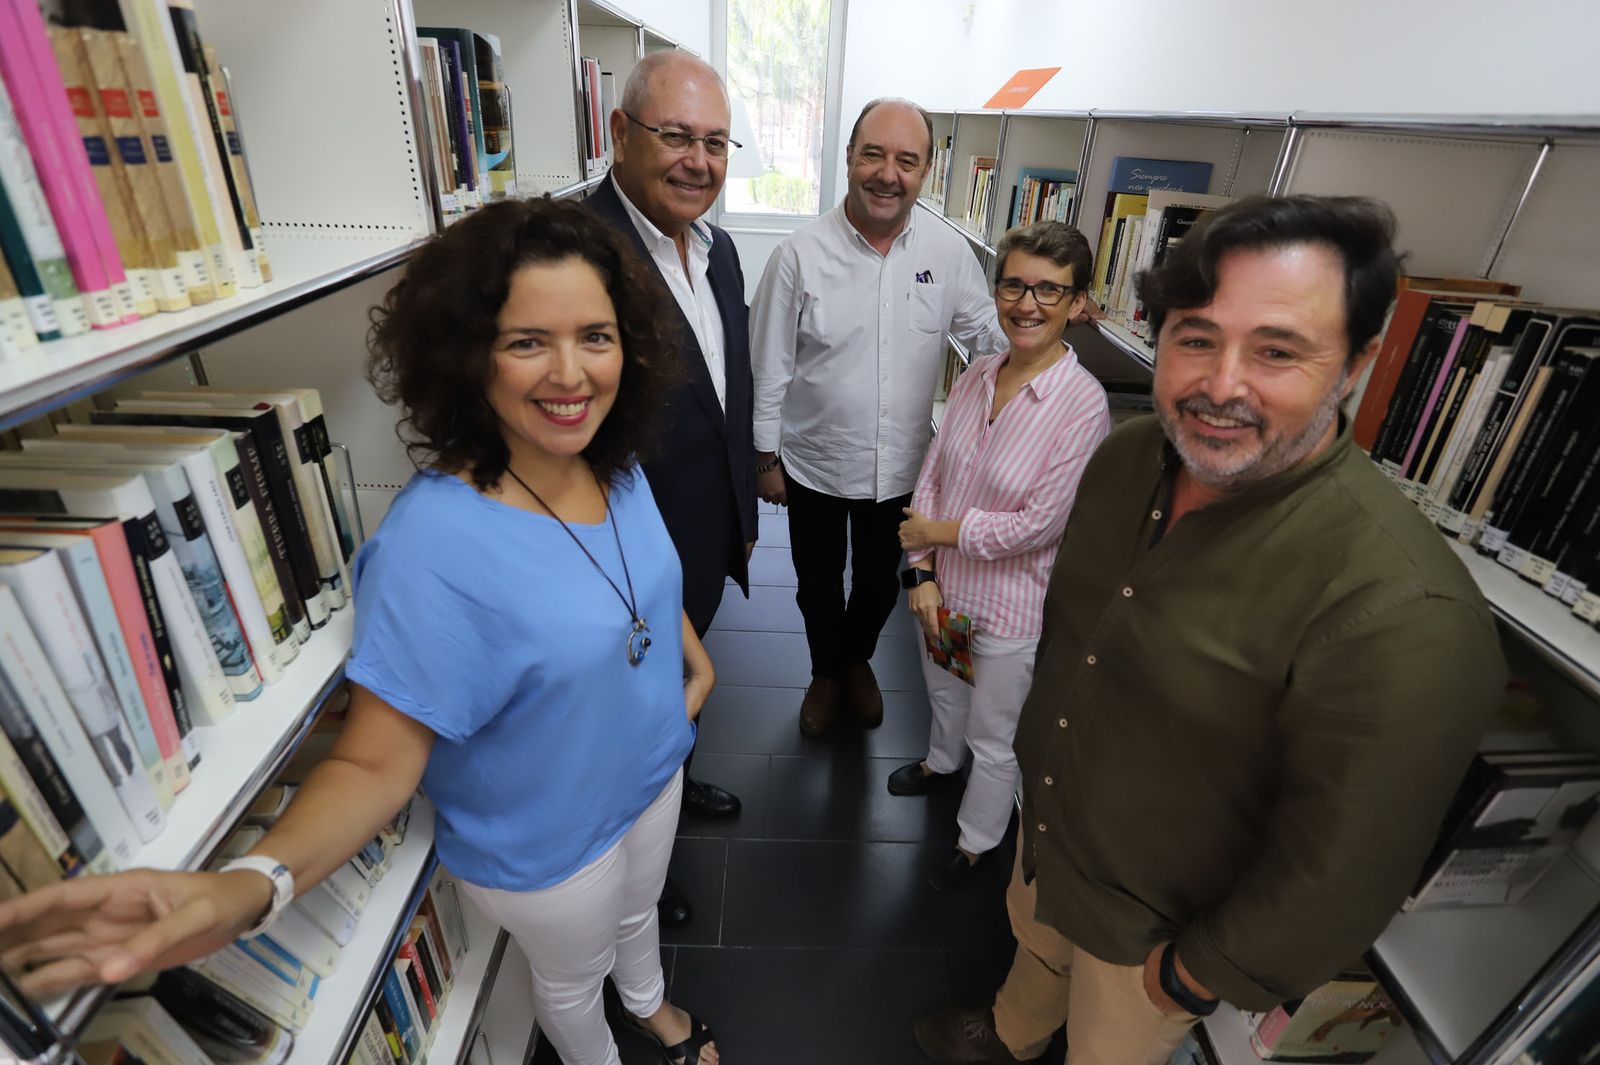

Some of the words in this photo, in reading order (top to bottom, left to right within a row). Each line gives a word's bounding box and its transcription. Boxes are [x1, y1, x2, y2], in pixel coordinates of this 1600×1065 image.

[1129, 168, 1168, 185] Siempre
[247, 447, 269, 498] FIRME
[265, 500, 288, 561] TIERRA
